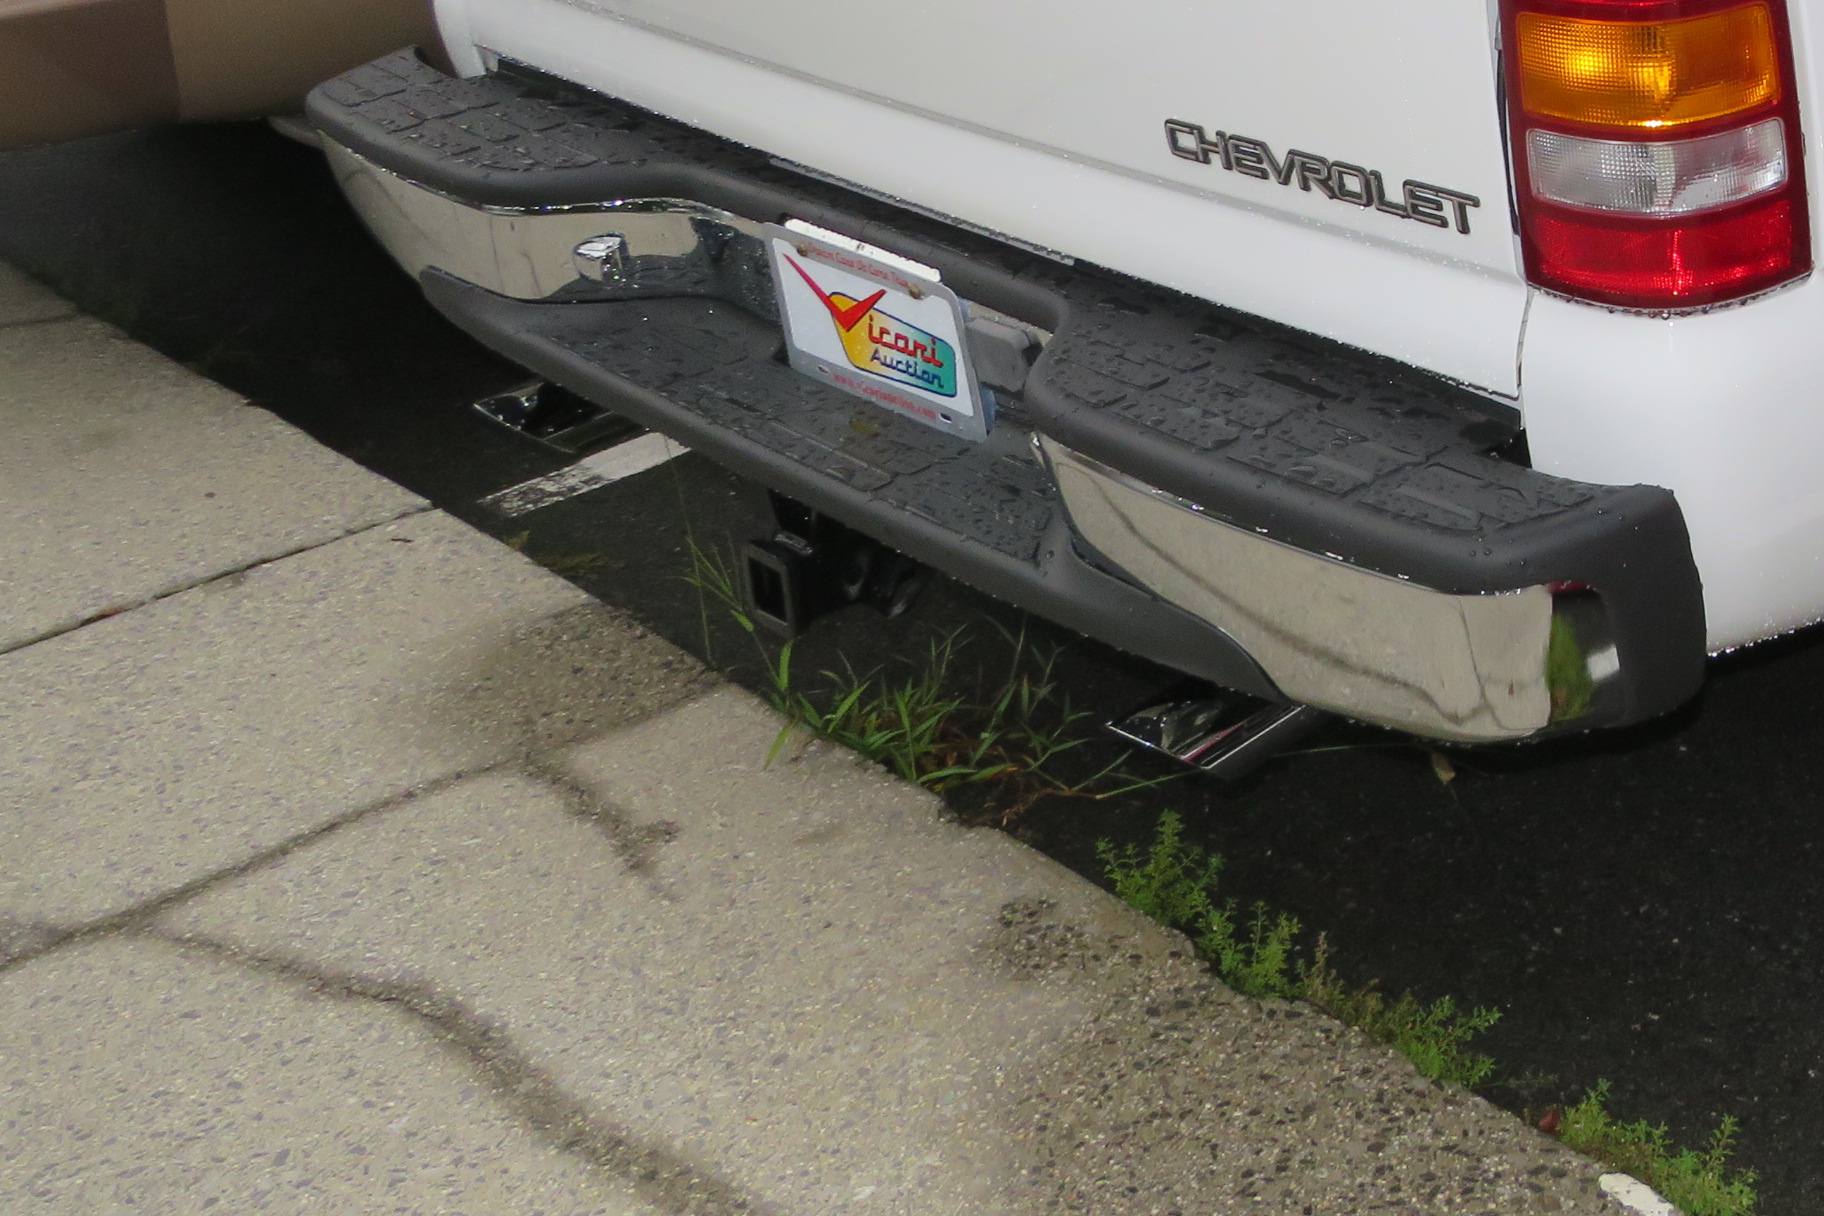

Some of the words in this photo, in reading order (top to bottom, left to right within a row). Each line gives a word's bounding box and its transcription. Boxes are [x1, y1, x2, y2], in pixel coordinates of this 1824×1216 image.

[1164, 118, 1480, 234] CHEVROLET
[782, 253, 943, 367] Vicari
[870, 348, 944, 389] Auction
